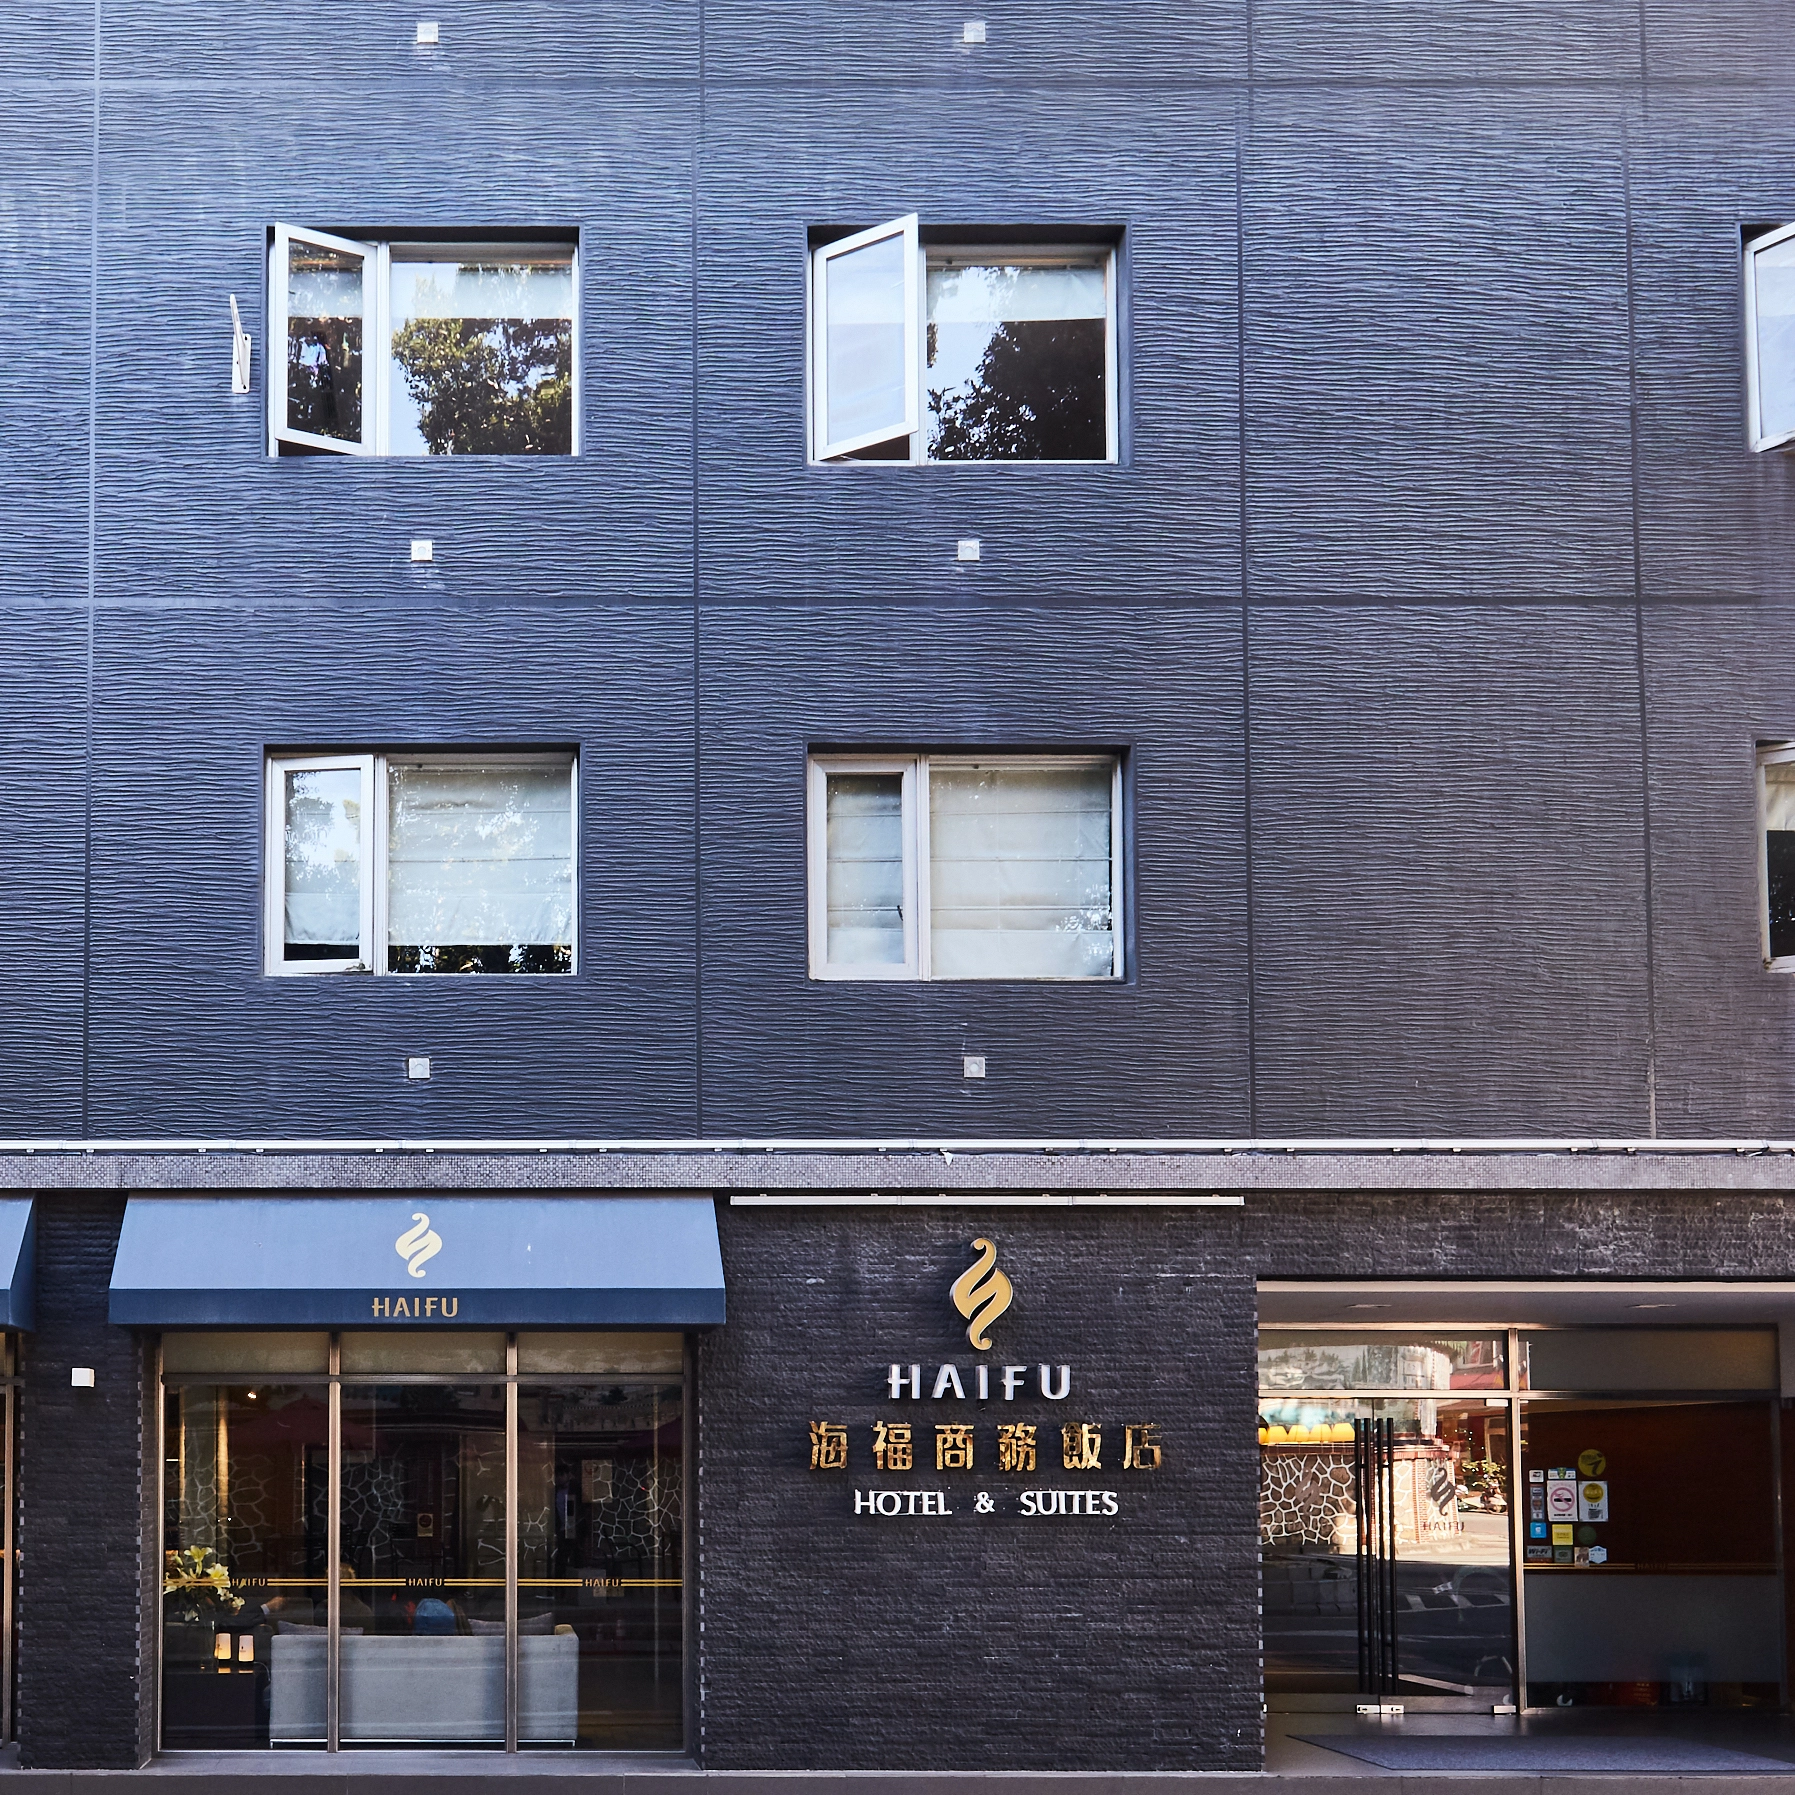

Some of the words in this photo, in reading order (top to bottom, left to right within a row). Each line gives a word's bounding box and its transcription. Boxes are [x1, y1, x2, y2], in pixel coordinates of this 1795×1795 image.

[371, 1296, 459, 1318] HAIFU
[887, 1362, 1072, 1401] HAIFU
[808, 1420, 1164, 1472] 海福商務飯店
[853, 1489, 953, 1516] HOTEL
[973, 1490, 996, 1515] &
[1019, 1489, 1120, 1517] SUITES
[1422, 1521, 1465, 1532] HAIFU
[408, 1578, 443, 1587] HAIFU
[585, 1578, 619, 1588] HAIFU
